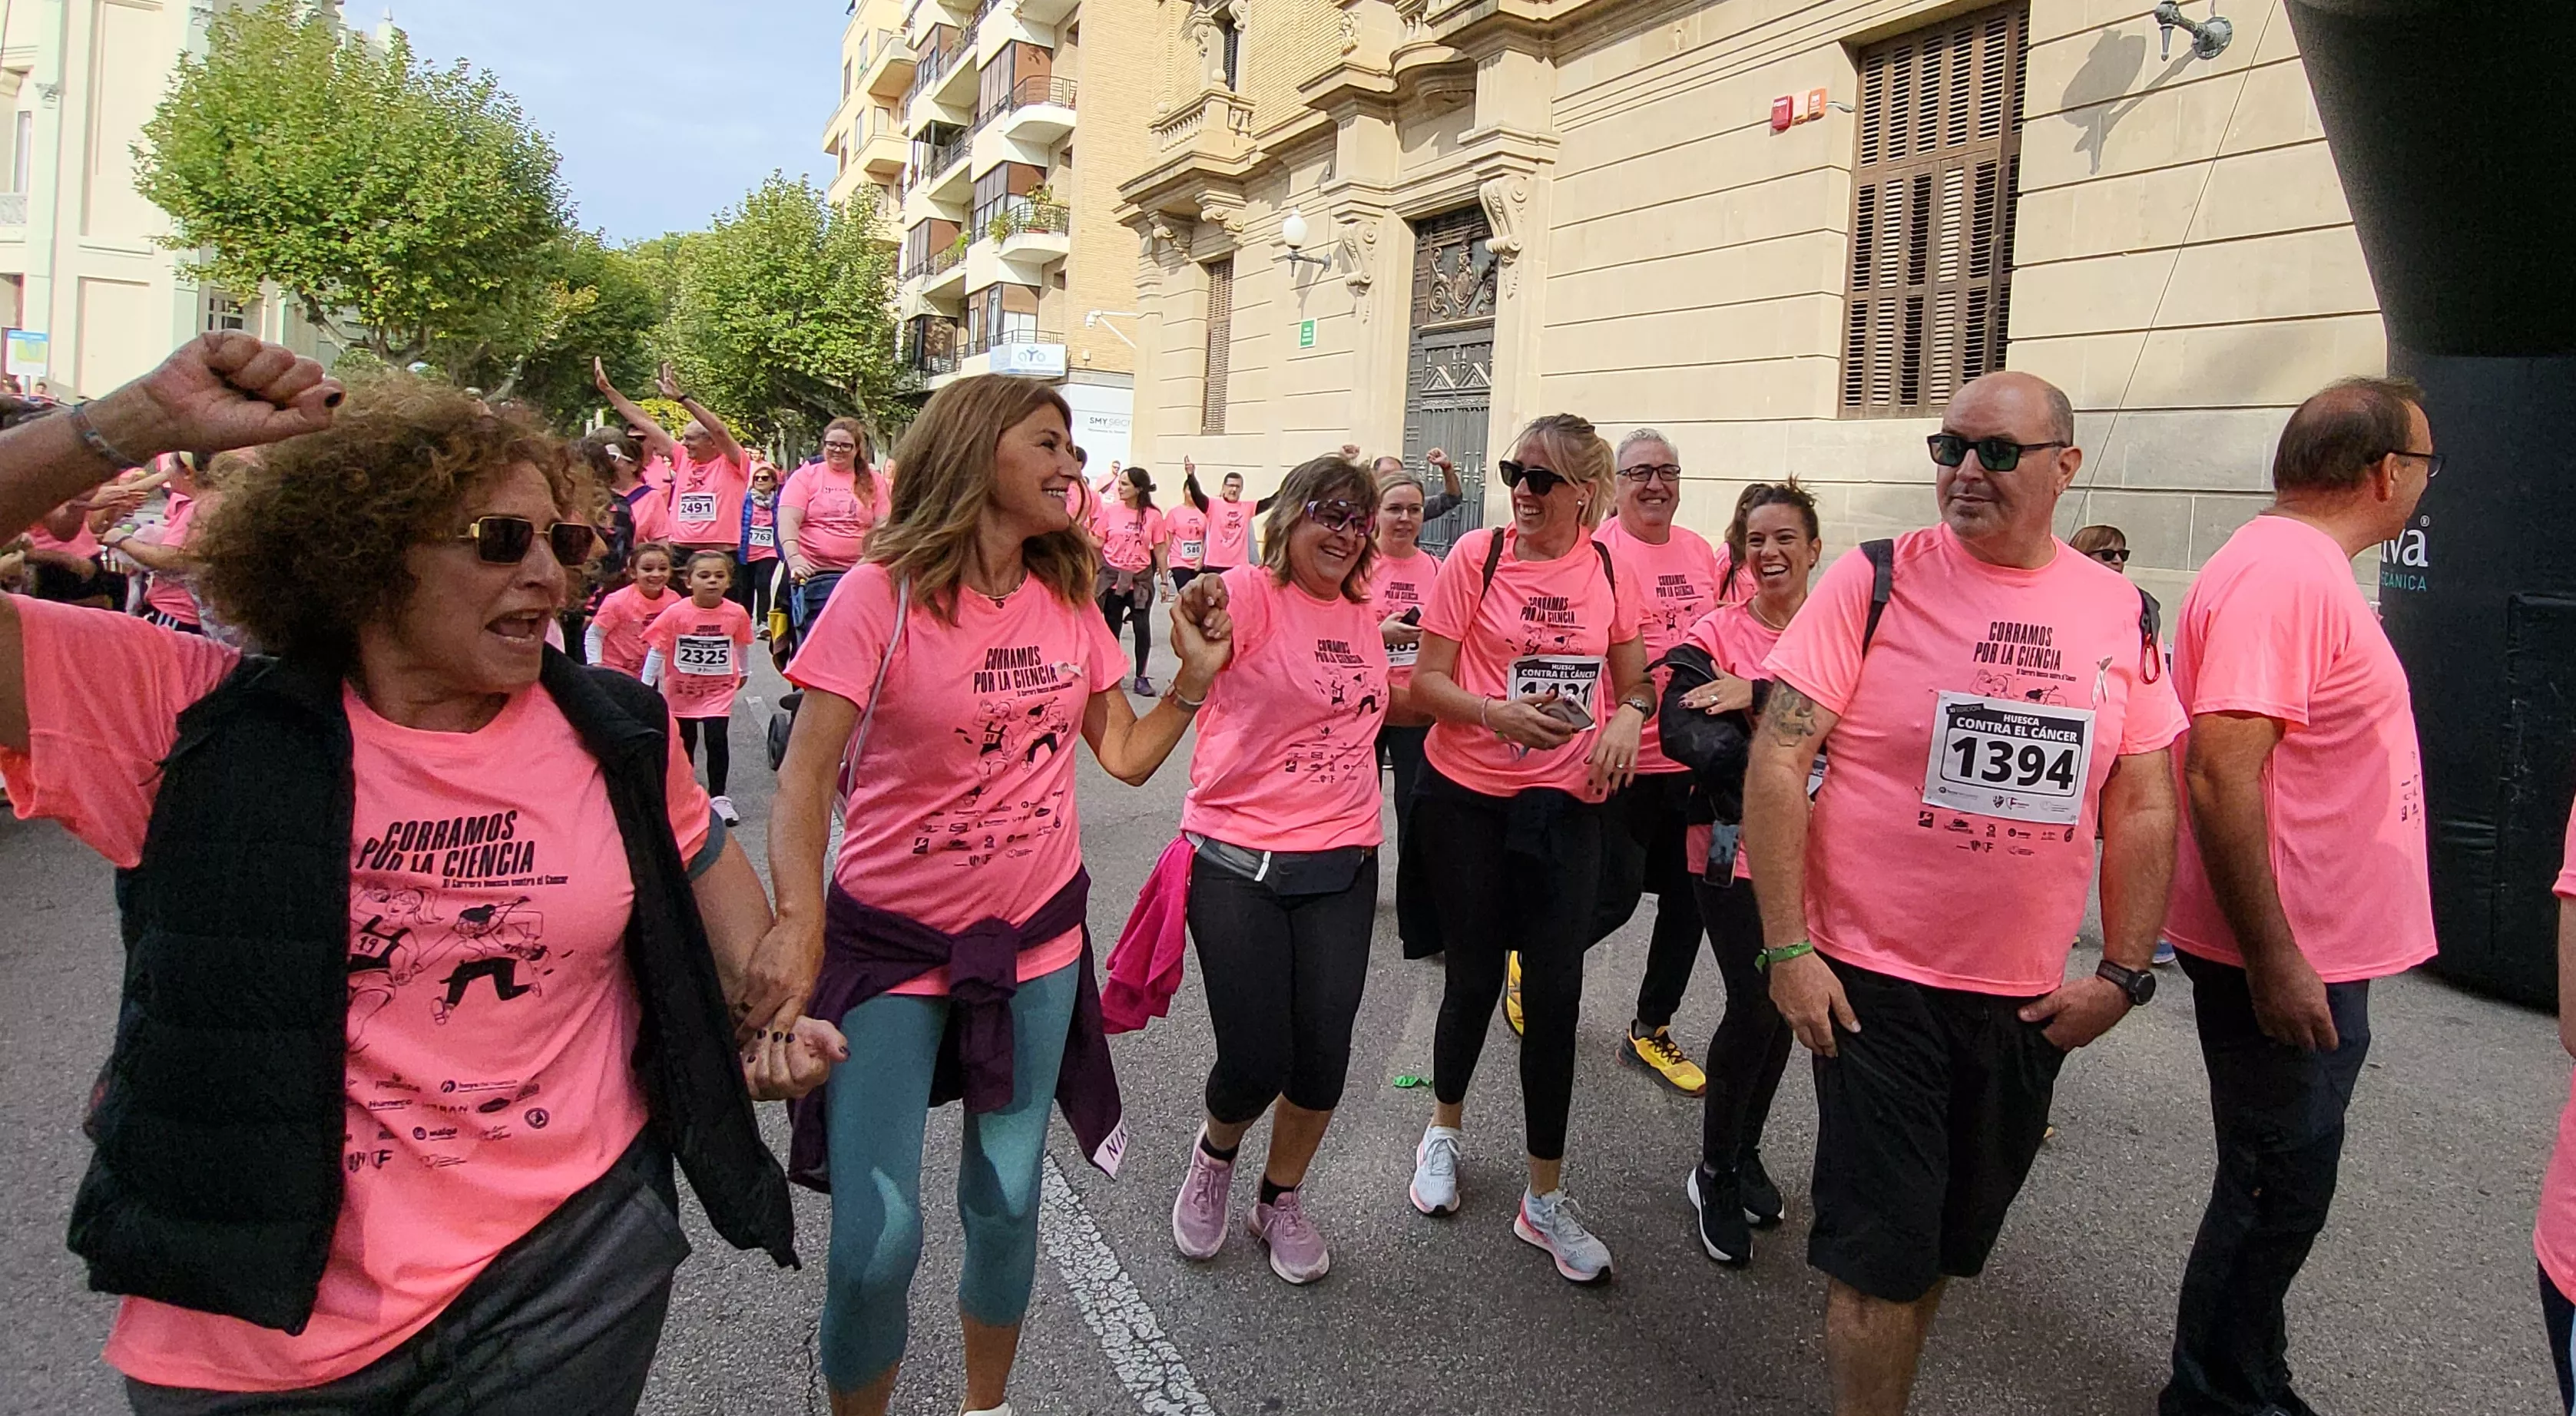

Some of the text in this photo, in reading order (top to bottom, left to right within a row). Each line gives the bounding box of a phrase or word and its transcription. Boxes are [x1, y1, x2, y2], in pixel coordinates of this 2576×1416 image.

[680, 502, 711, 514] 2491
[1988, 621, 2053, 647] CORRAMOS
[680, 648, 727, 664] 2325
[985, 646, 1041, 670] CORRAMOS
[1973, 642, 2061, 670] POR LA CIENCIA
[973, 663, 1059, 693] POR LA CIENCIA
[1521, 669, 1558, 678] CONTRA
[1956, 717, 2078, 743] CONTRA EL CÁNCER
[2002, 714, 2040, 726] HUESCA
[1951, 736, 2075, 791] 1394
[384, 810, 518, 852] CORRAMOS
[356, 837, 535, 879] POR LA CIENCIA
